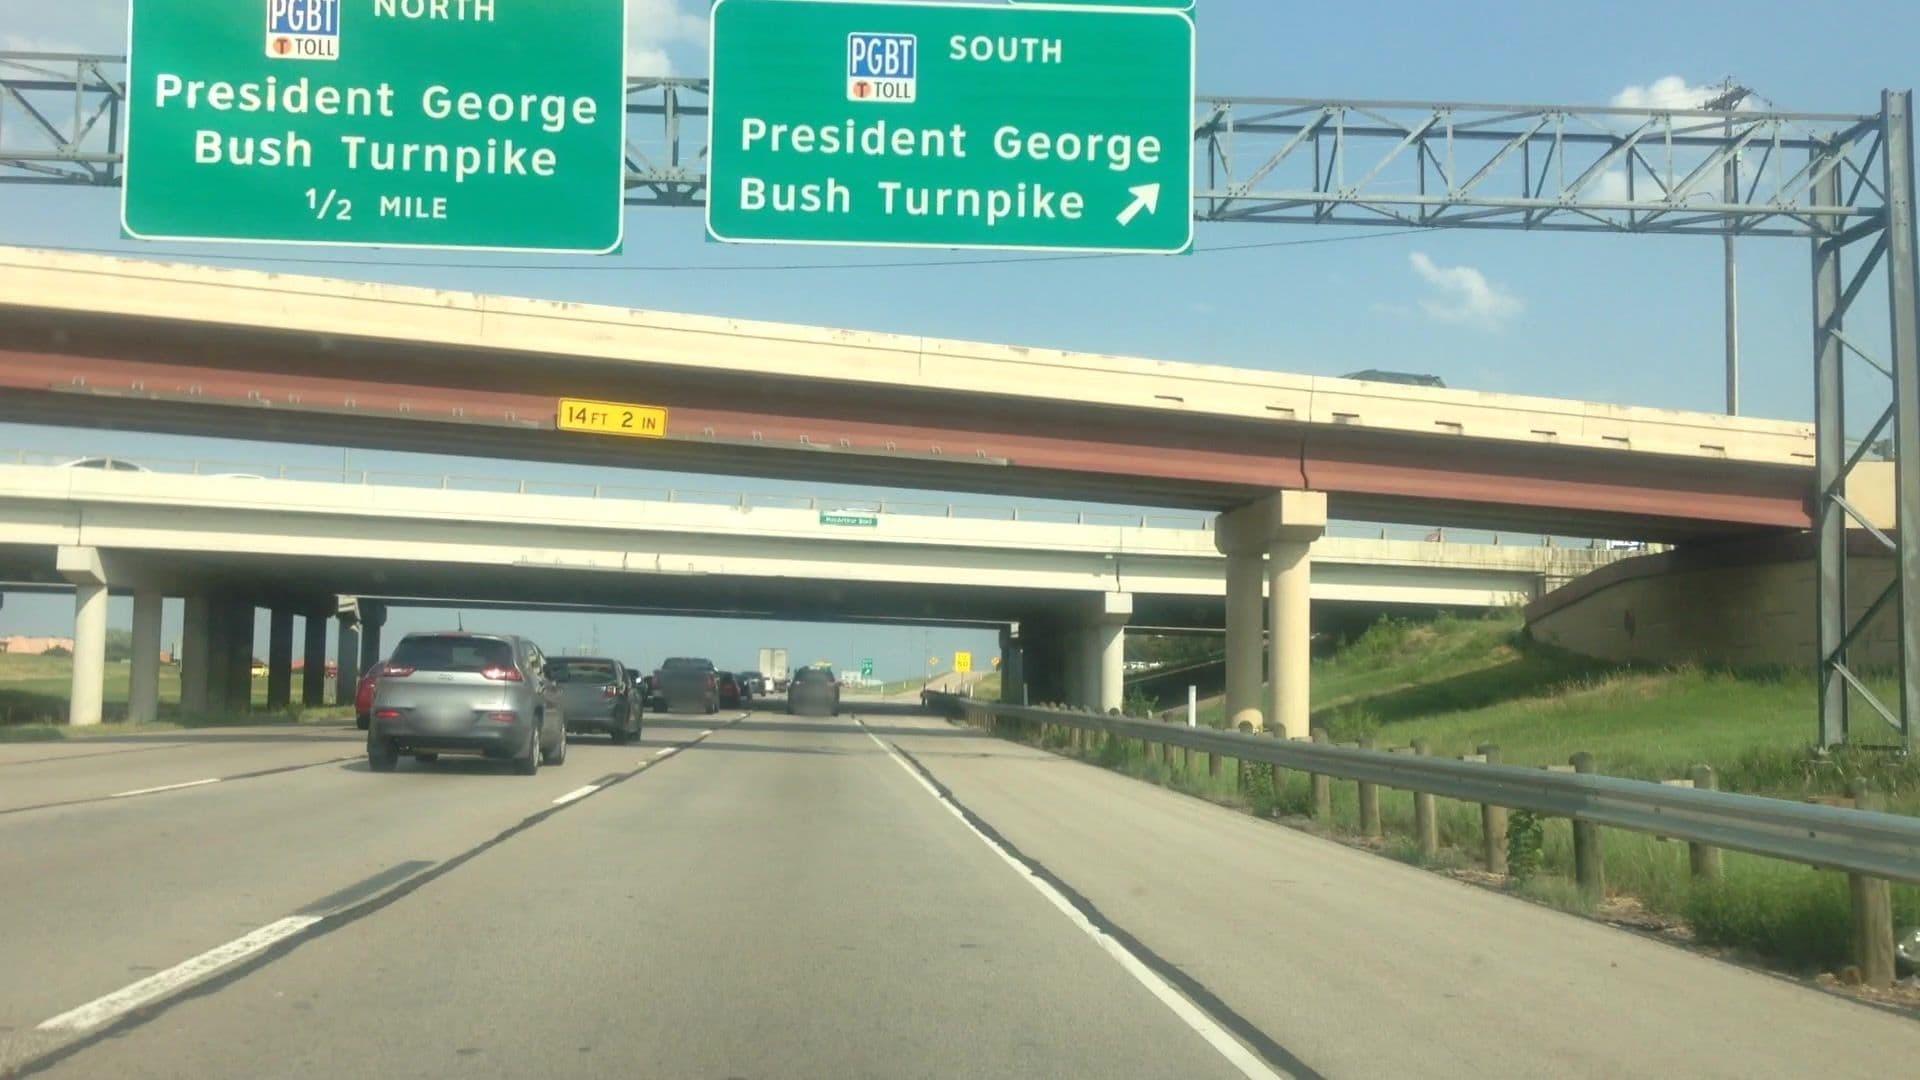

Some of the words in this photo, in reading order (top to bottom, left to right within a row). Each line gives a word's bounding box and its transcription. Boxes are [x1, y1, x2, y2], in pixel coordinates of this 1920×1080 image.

[270, 0, 333, 32] PGBT
[374, 0, 495, 22] NORTH
[295, 39, 335, 56] TOLL
[851, 38, 912, 76] PGBT
[949, 35, 1062, 64] SOUTH
[156, 74, 394, 117] President
[422, 85, 597, 132] George
[873, 81, 911, 99] TOLL
[195, 130, 312, 167] Bush
[341, 135, 557, 182] Turnpike
[742, 118, 967, 159] President
[993, 125, 1161, 171] George
[305, 188, 352, 220] 1/2
[380, 195, 447, 219] MILE
[740, 177, 850, 213] Bush
[878, 181, 1084, 226] Turnpike
[621, 411, 633, 428] 2
[641, 417, 656, 430] IN
